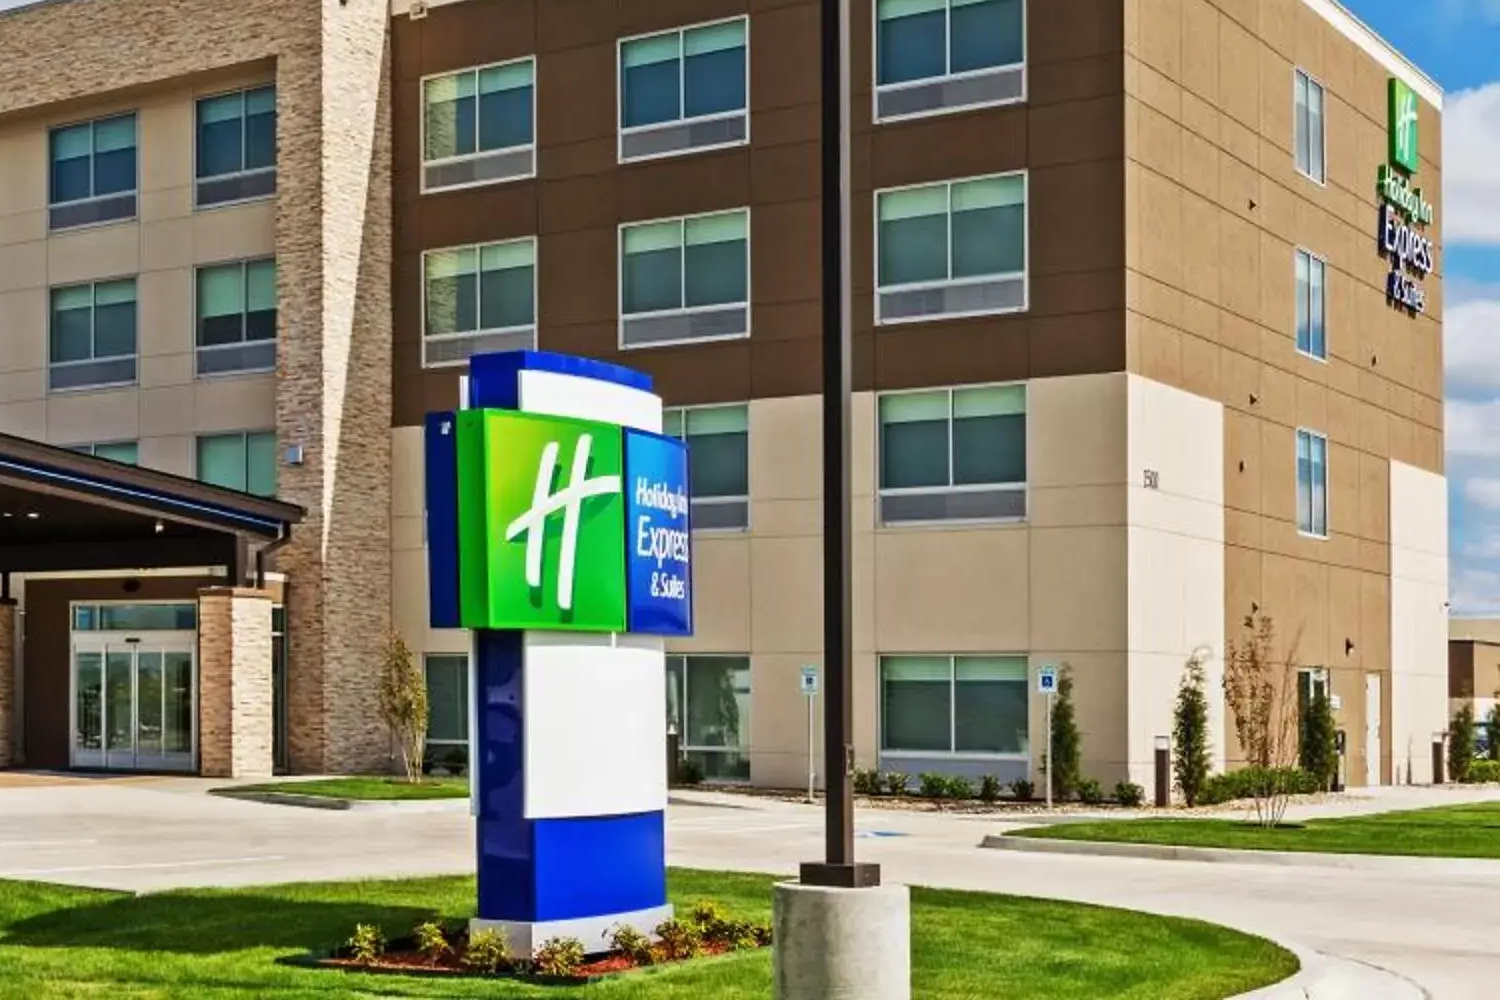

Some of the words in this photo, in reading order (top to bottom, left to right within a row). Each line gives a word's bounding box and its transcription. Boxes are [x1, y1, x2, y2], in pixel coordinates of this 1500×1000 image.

[1383, 165, 1419, 223] Holiday
[1419, 187, 1433, 225] Inn
[1385, 204, 1432, 274] Express
[635, 476, 678, 519] Holiday
[650, 571, 660, 597] &
[660, 572, 685, 599] Suites
